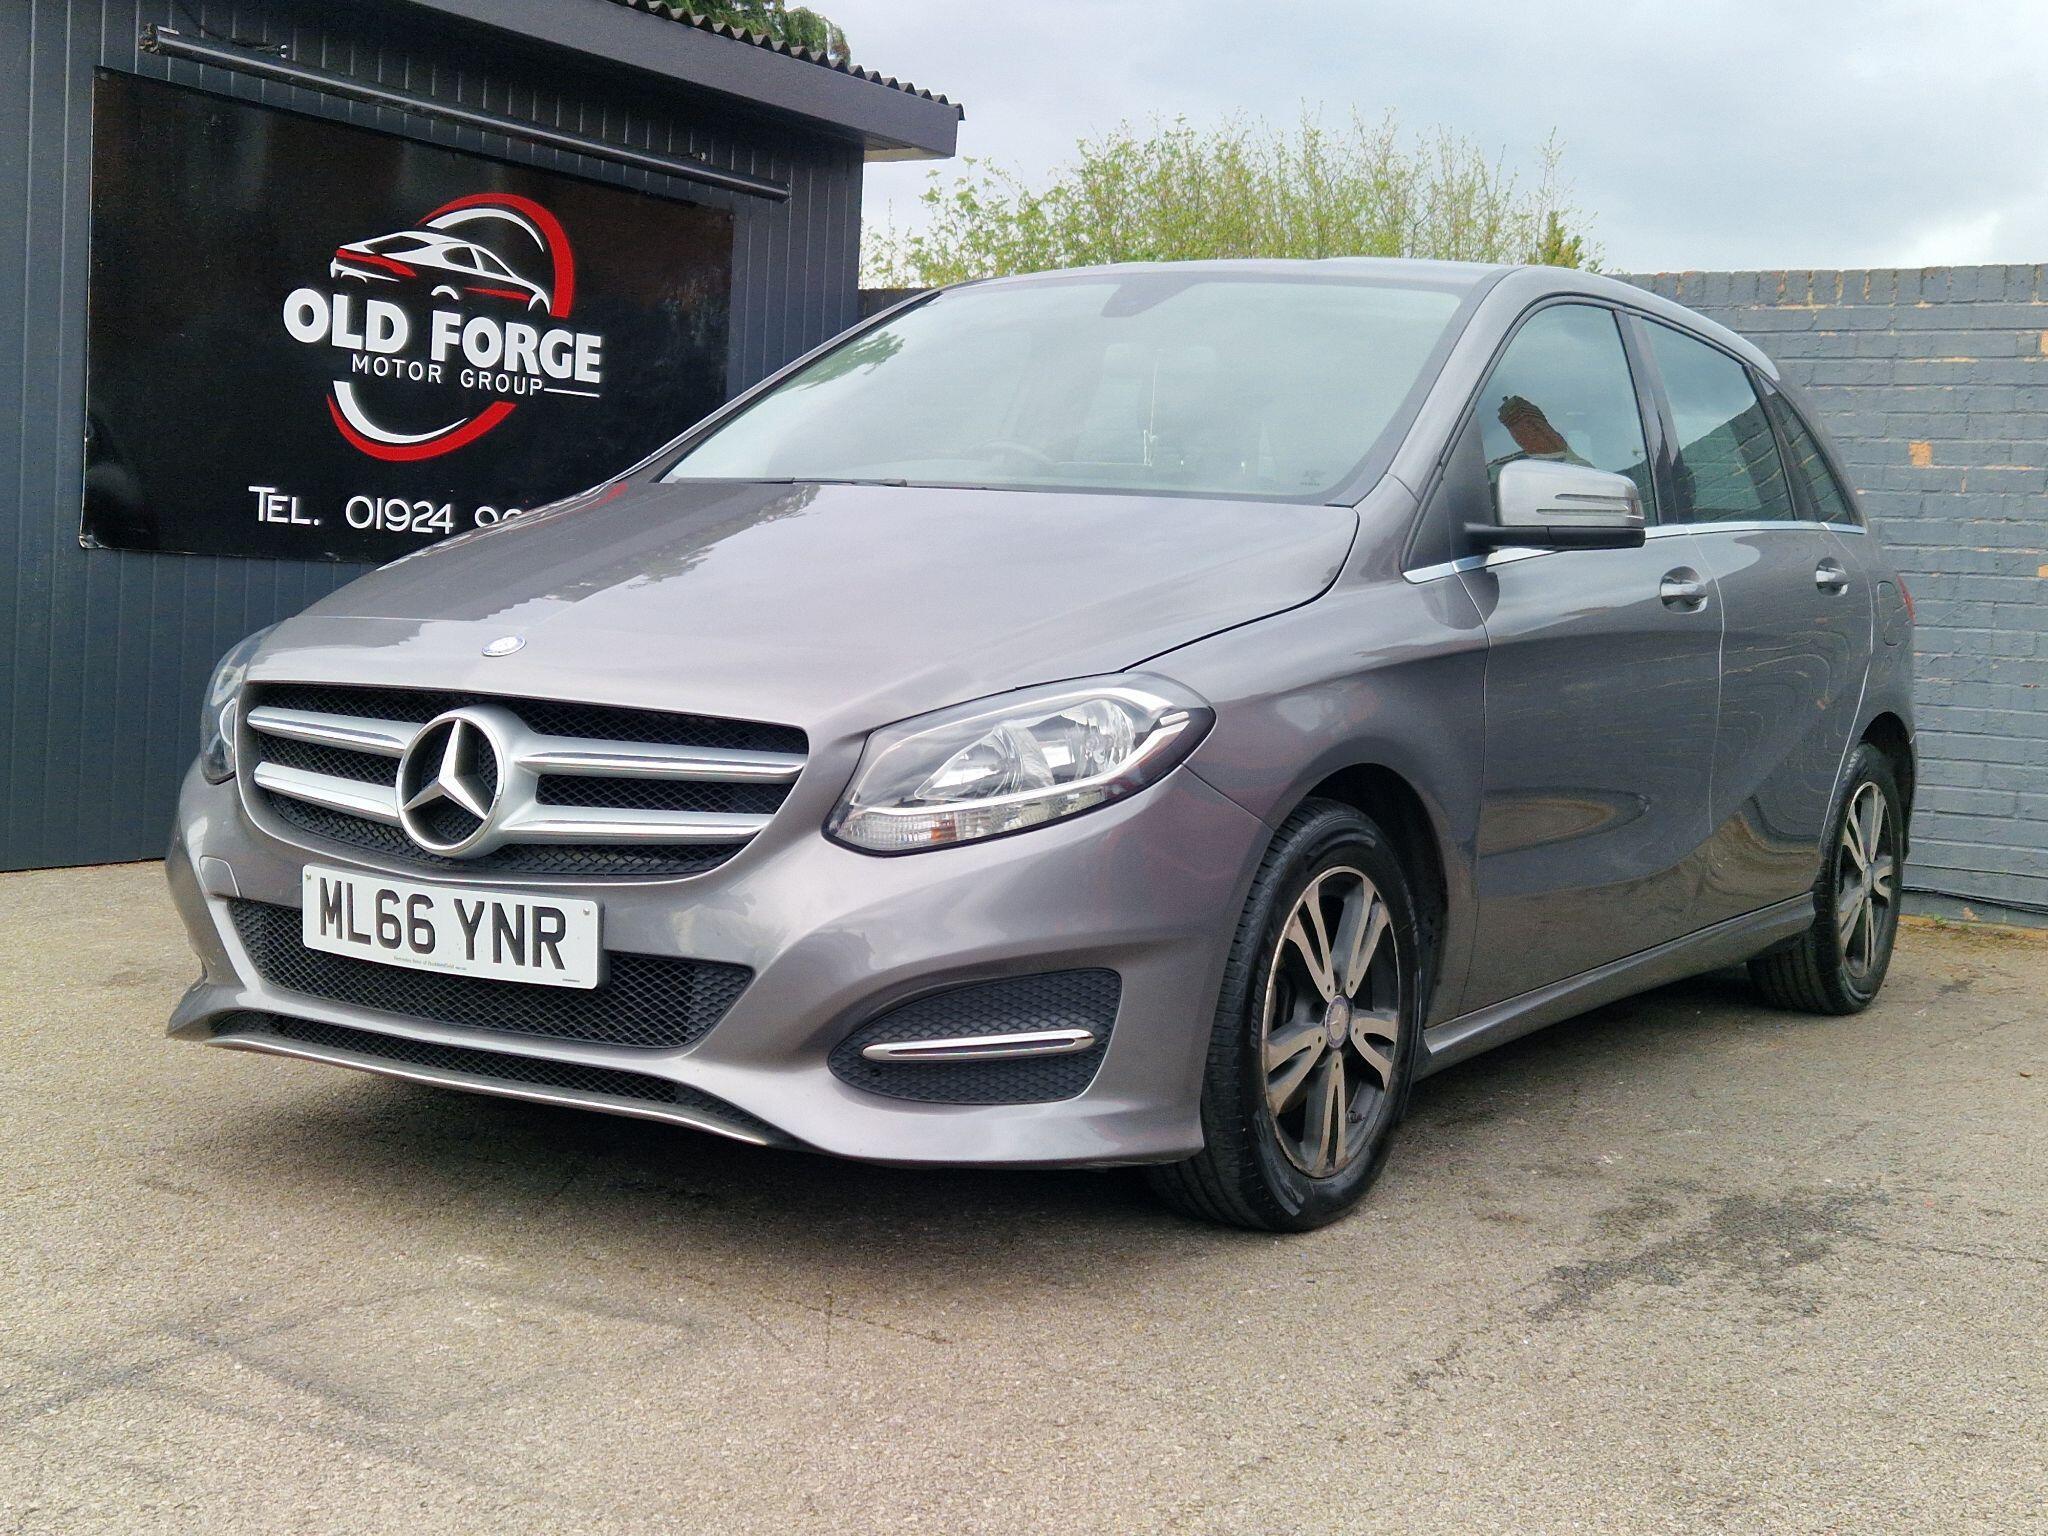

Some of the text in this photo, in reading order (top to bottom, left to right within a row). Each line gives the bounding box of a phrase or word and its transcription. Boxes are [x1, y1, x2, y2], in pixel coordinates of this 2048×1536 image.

[282, 287, 603, 384] OLD FORGE
[351, 353, 543, 396] MOTOR GROUP
[248, 485, 321, 526] TEL.
[345, 495, 454, 535] 01924
[319, 877, 567, 971] ML66 YNR
